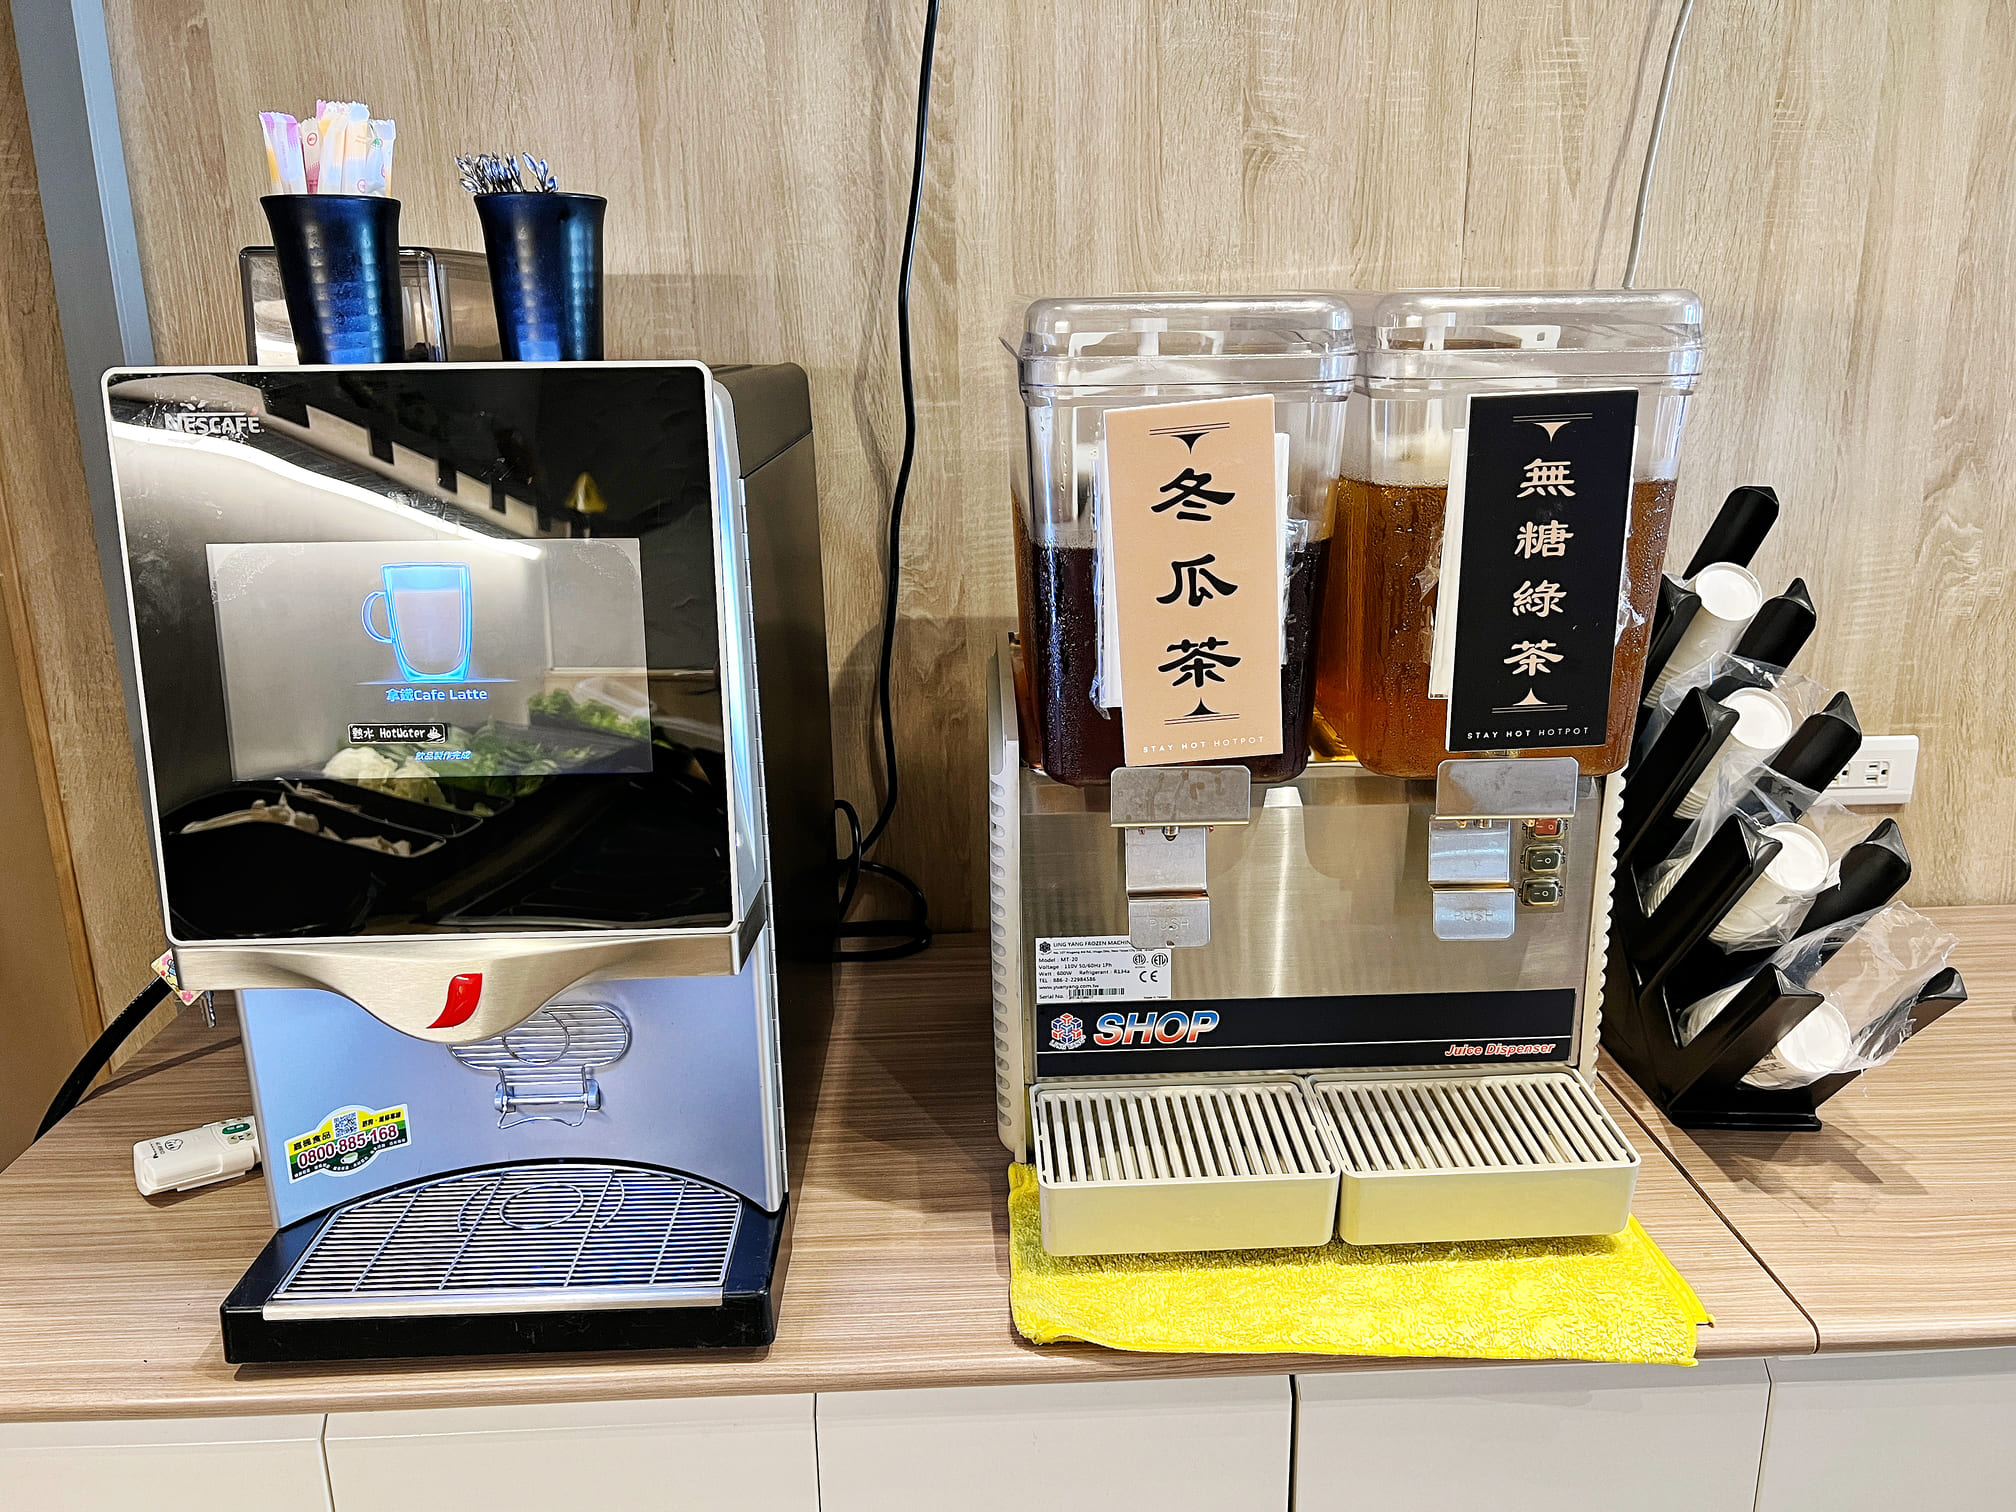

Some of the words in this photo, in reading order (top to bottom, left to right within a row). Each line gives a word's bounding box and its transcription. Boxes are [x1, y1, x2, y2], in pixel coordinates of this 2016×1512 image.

[1503, 458, 1577, 677] 無糖綠茶
[1150, 467, 1242, 688] 冬瓜茶
[449, 689, 488, 701] Latte
[379, 727, 426, 739] HotWater
[1467, 731, 1498, 740] STAY
[1506, 729, 1531, 738] HOT
[1538, 727, 1589, 737] HOTPOT
[1143, 744, 1173, 753] STAY
[1181, 741, 1206, 750] HOT
[1214, 736, 1264, 747] HOTPOT
[1455, 910, 1494, 923] PUSH
[1149, 918, 1190, 931] PUSH
[1139, 970, 1158, 983] CE
[1093, 1010, 1220, 1046] SHOP
[1445, 1044, 1483, 1056] Juice
[1485, 1042, 1556, 1057] Dispenser
